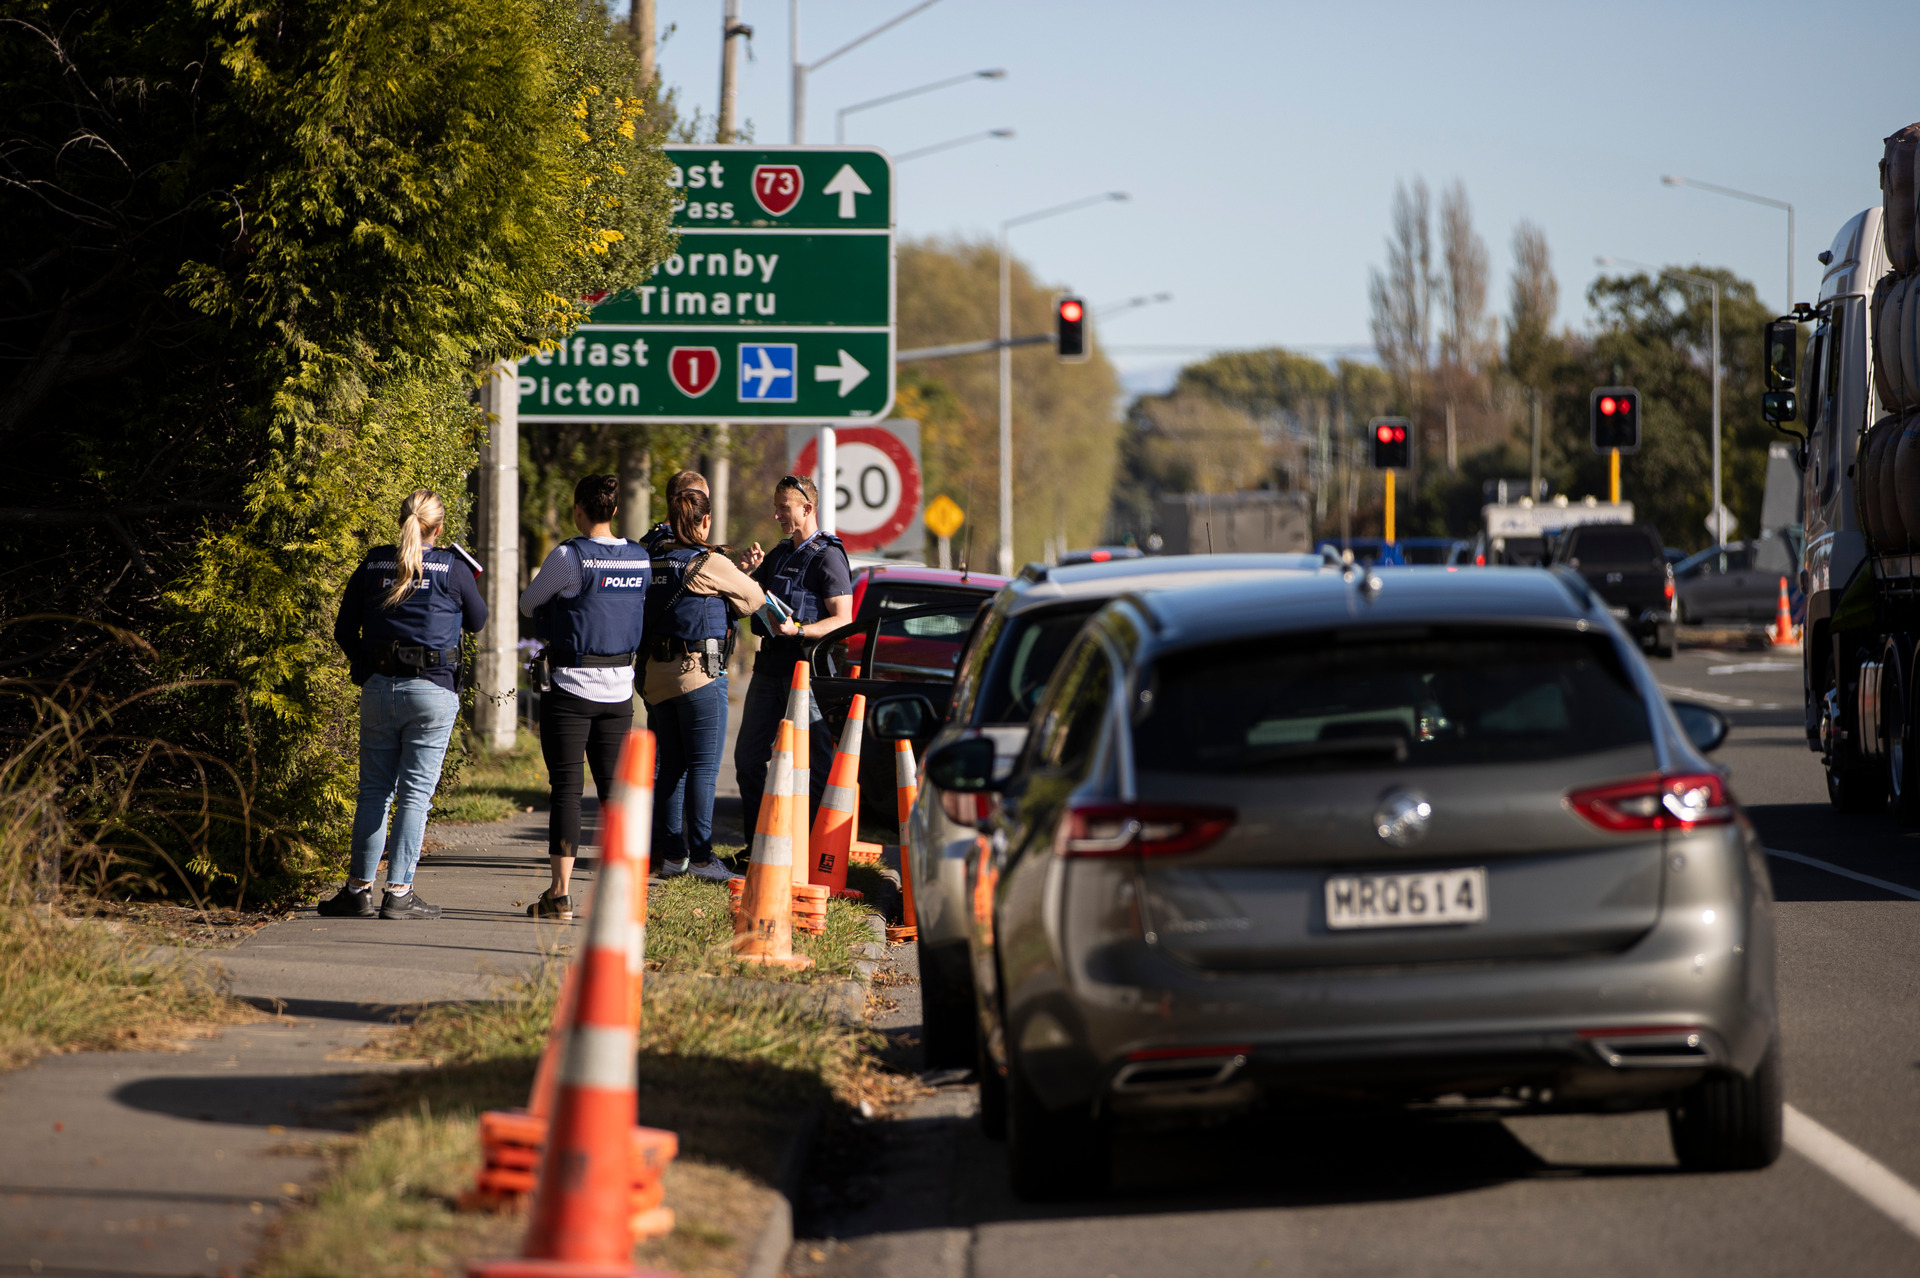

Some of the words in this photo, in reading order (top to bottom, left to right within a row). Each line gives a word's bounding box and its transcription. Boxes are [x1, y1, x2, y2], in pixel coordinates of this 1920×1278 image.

[666, 160, 724, 189] ast
[760, 172, 794, 195] 73
[652, 248, 779, 283] ornby
[636, 286, 776, 315] Timaru
[688, 357, 698, 386] 1
[518, 376, 640, 406] Picton
[382, 578, 430, 589] POCE
[604, 577, 643, 588] POLICE
[651, 575, 668, 585] LICE
[1334, 878, 1474, 917] MRQ614
